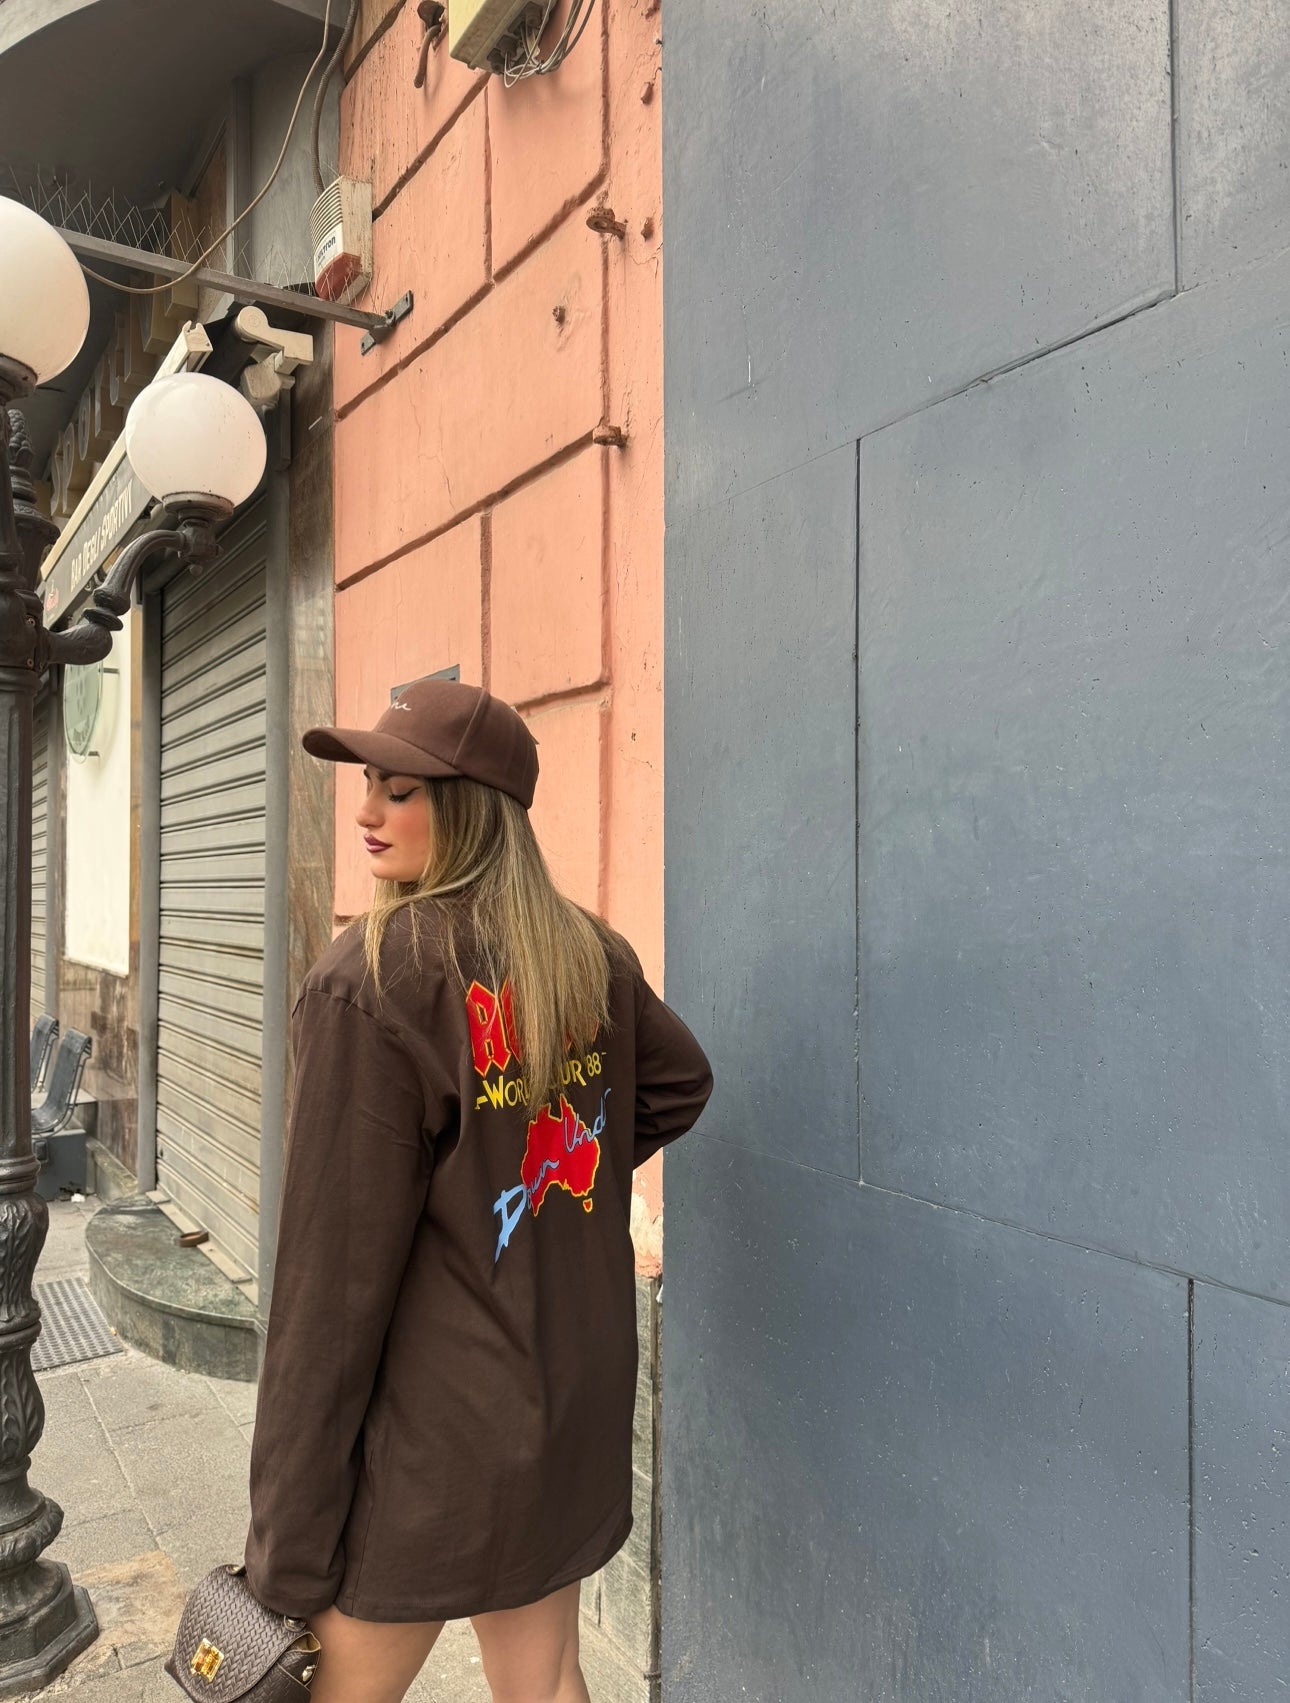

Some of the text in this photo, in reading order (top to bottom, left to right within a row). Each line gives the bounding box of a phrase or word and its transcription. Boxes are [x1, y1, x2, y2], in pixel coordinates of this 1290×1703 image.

[71, 478, 133, 593] BAR DEGLI SPORTIVI
[548, 1059, 587, 1087] UR
